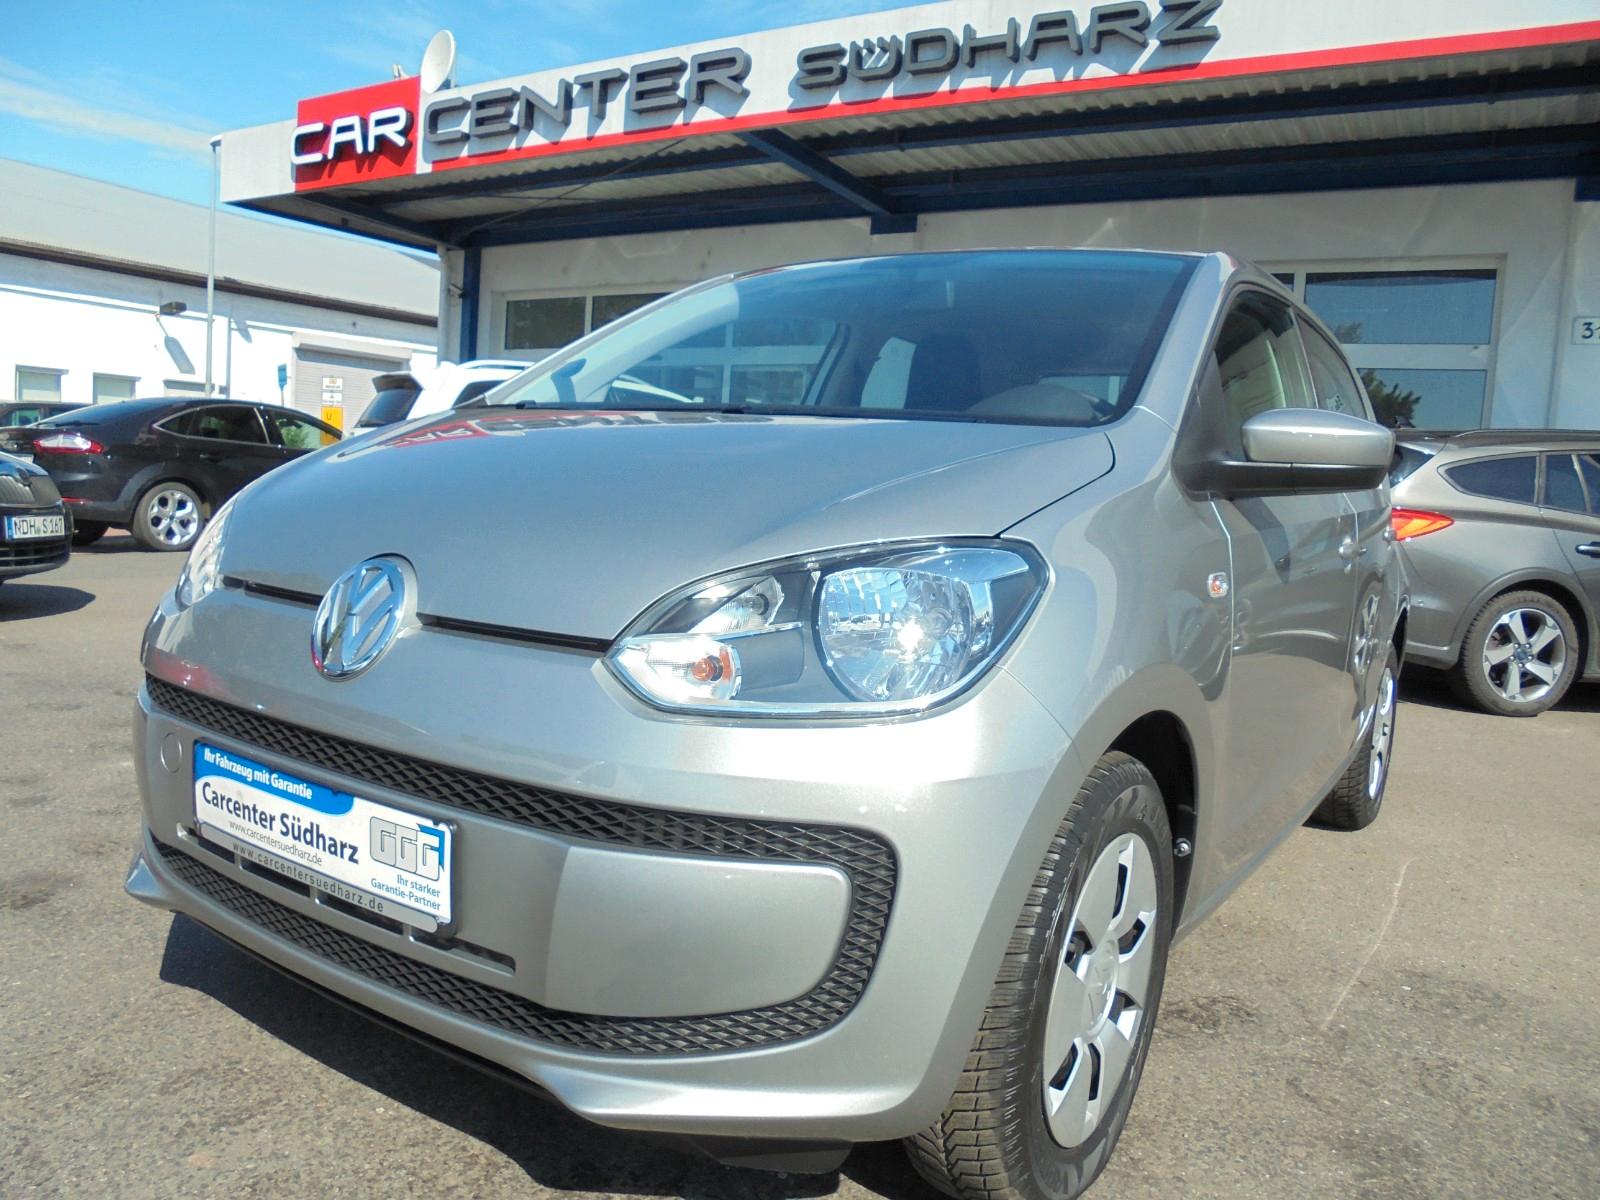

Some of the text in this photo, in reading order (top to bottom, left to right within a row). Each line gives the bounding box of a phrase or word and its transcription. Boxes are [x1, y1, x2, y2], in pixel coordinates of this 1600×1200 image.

[290, 0, 1221, 165] CAR CENTER SÜDHARZ
[14, 519, 35, 536] NDH
[204, 747, 313, 800] Ihr Fahrzeug mit Garantie
[202, 781, 360, 864] Carcenter Südharz
[228, 820, 323, 867] www.carcentersuedharz.de
[232, 841, 384, 913] www.carcentersuedharz.de
[370, 878, 441, 911] Garantie-Partner
[397, 874, 441, 899] Ihr starker
